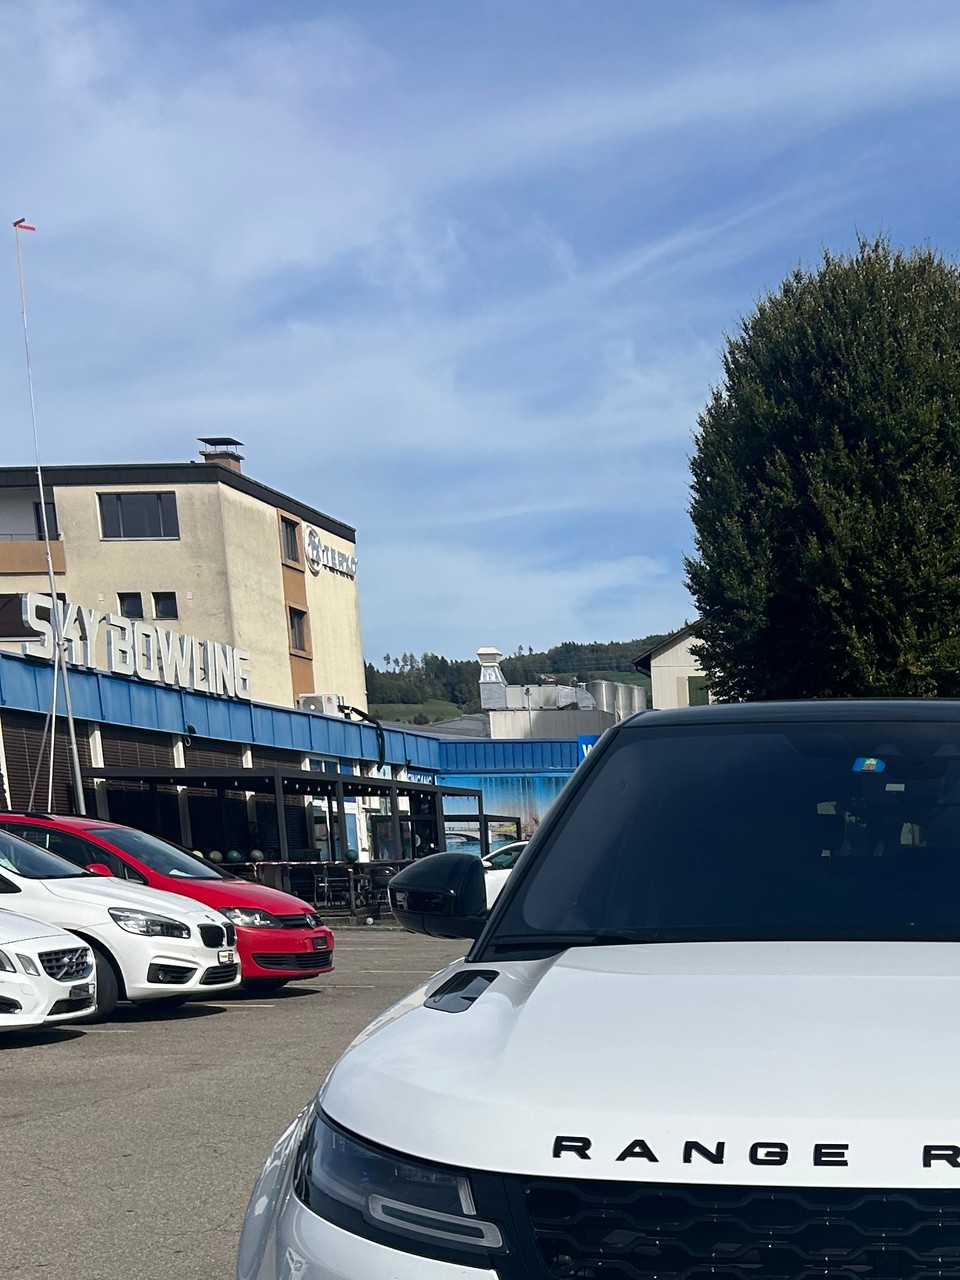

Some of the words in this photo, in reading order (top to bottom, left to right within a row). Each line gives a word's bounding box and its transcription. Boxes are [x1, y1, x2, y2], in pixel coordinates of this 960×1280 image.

[22, 592, 100, 668] SKY
[105, 612, 250, 700] BOWLING
[552, 1135, 849, 1167] RANGE
